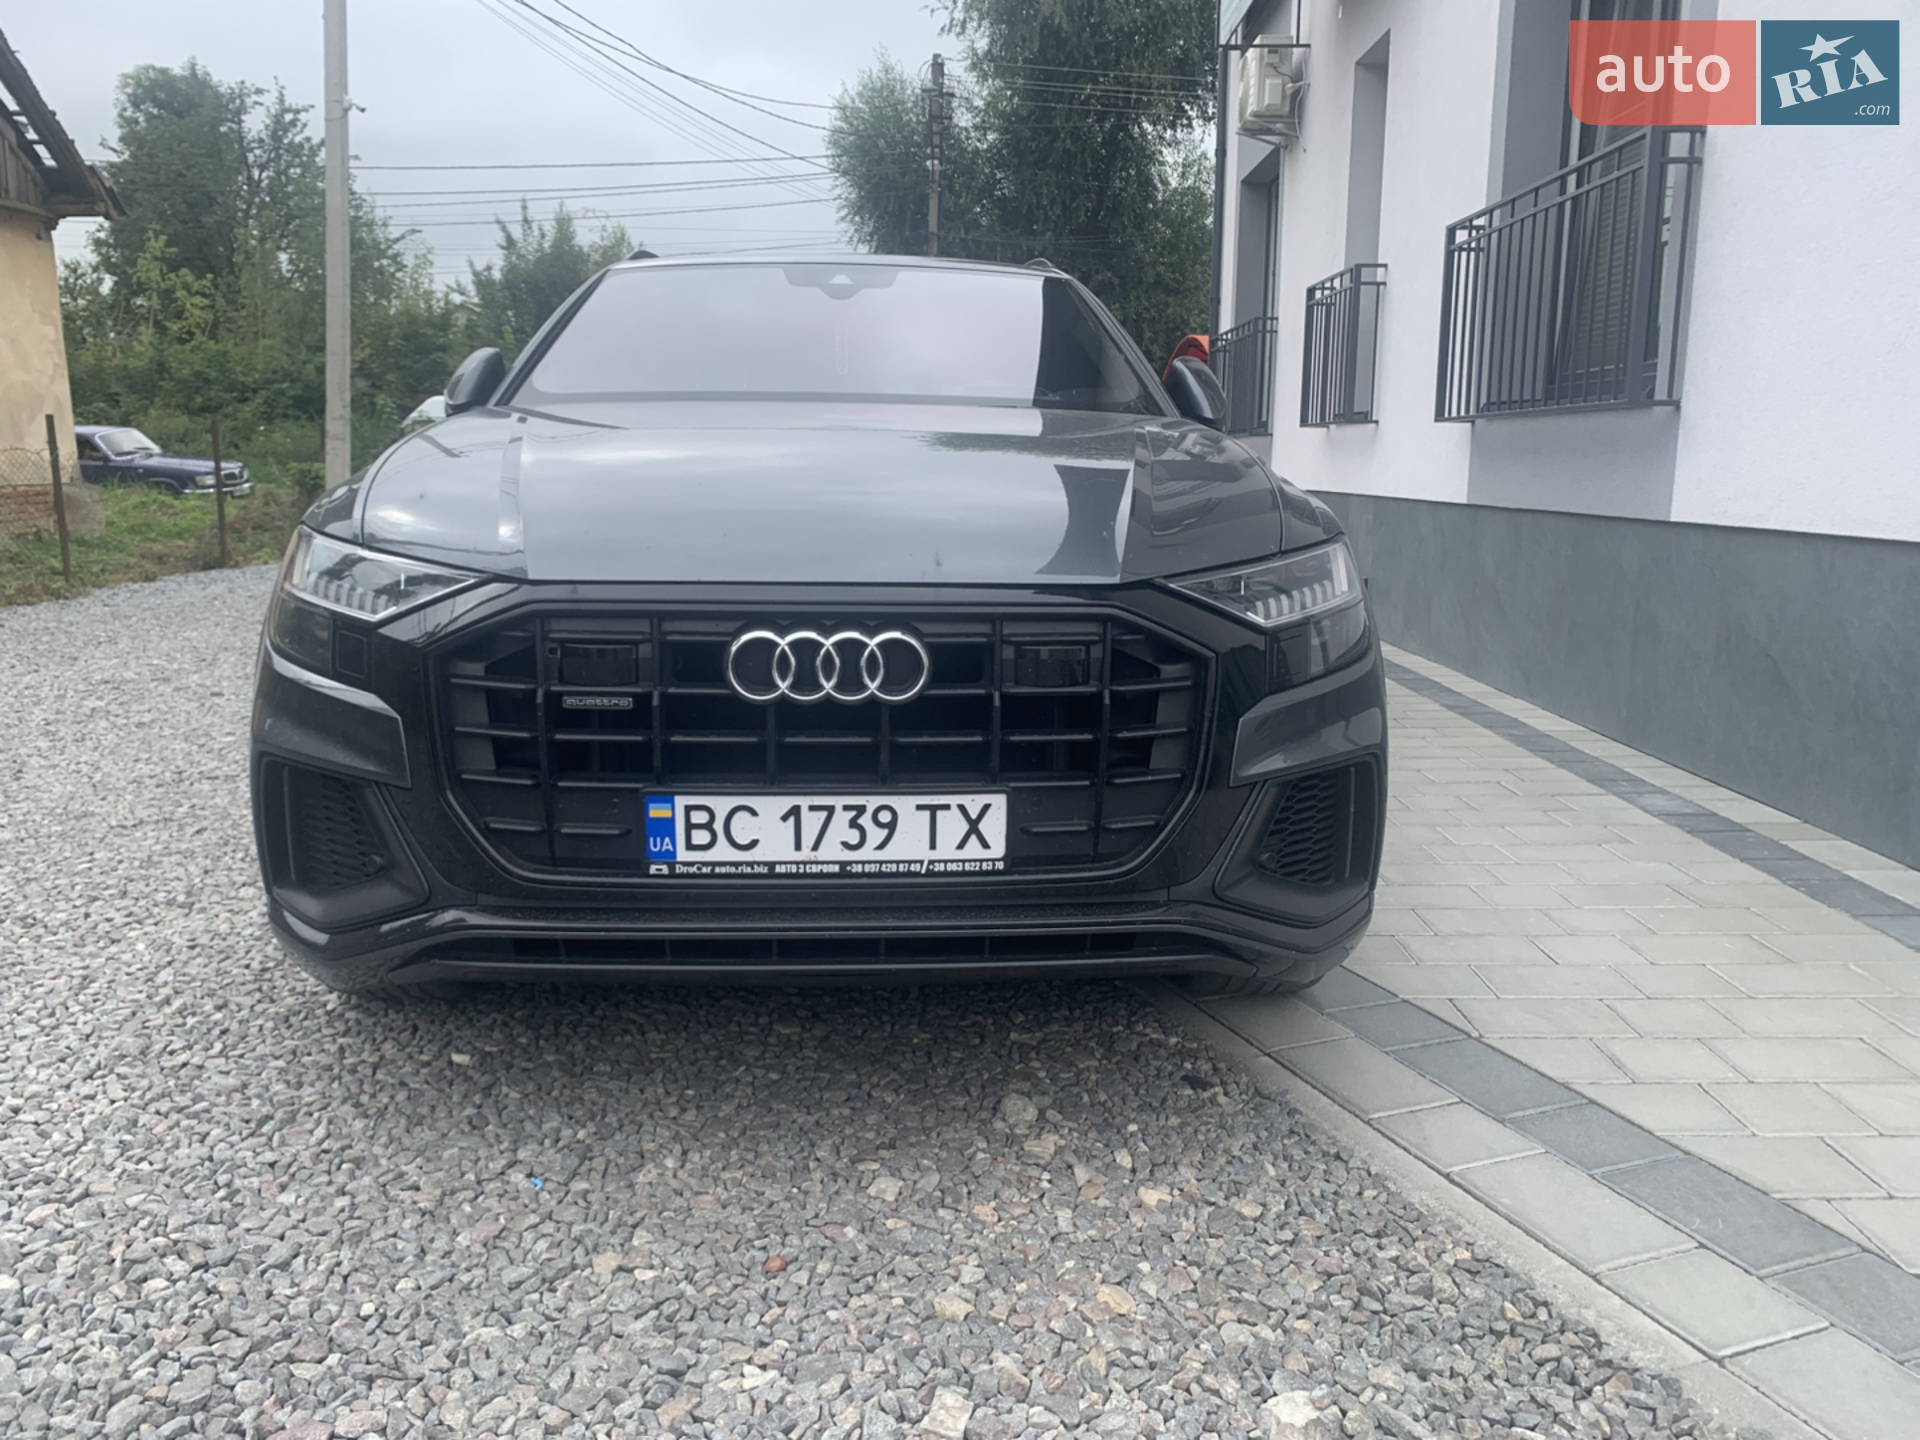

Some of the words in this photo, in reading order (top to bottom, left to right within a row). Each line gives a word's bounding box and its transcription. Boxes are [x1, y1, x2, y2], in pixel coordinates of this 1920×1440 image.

[565, 698, 630, 707] quattro
[684, 804, 760, 852] BC
[780, 804, 899, 852] 1739
[915, 803, 993, 851] TX
[649, 836, 674, 852] UA
